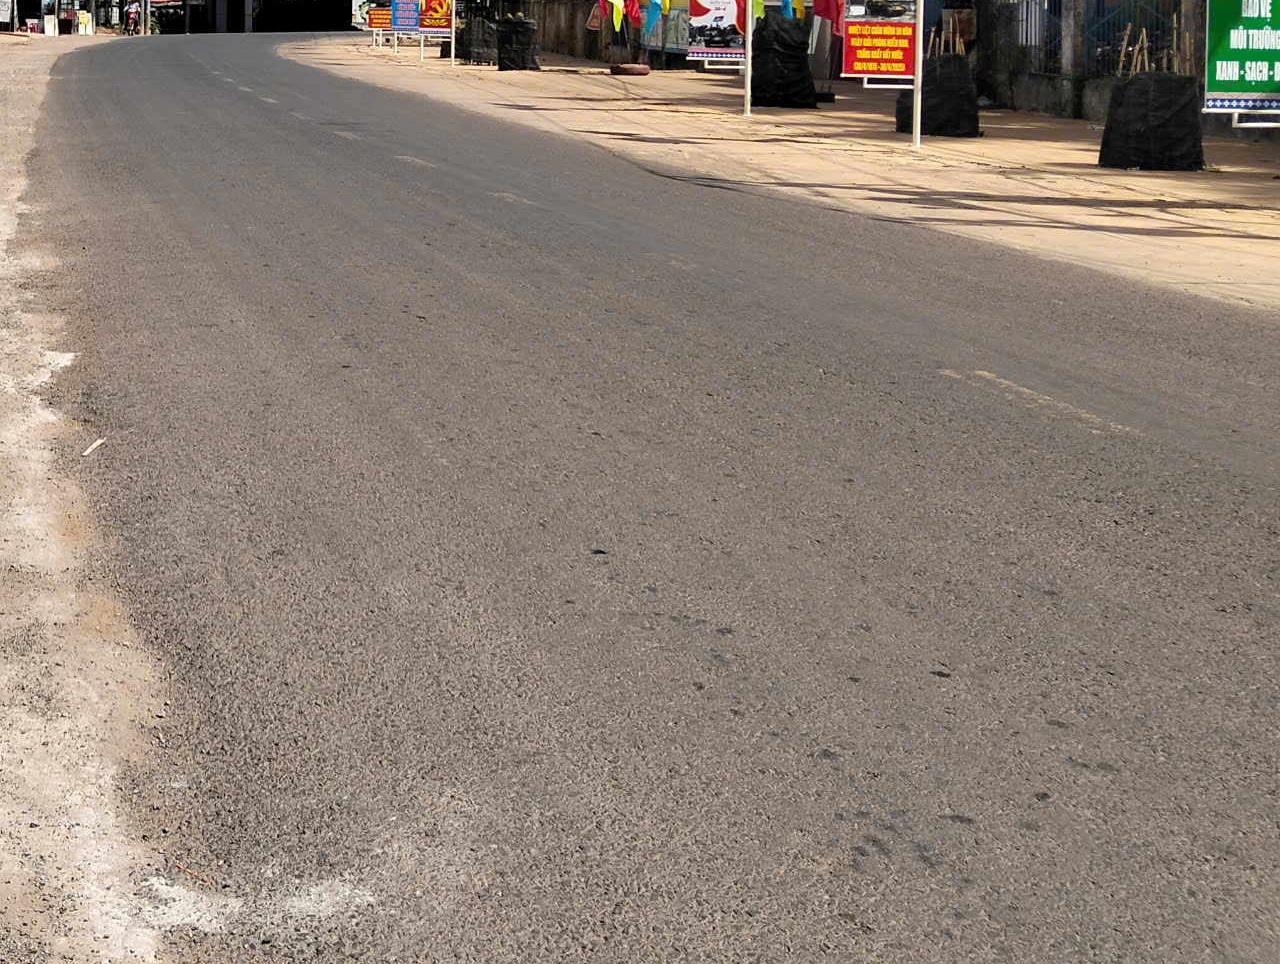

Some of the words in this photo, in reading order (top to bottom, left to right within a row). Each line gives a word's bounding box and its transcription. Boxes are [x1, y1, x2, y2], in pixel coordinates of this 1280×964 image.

[1230, 25, 1247, 49] MÔI
[1215, 60, 1239, 81] XANH
[1245, 61, 1269, 85] SẠCH
